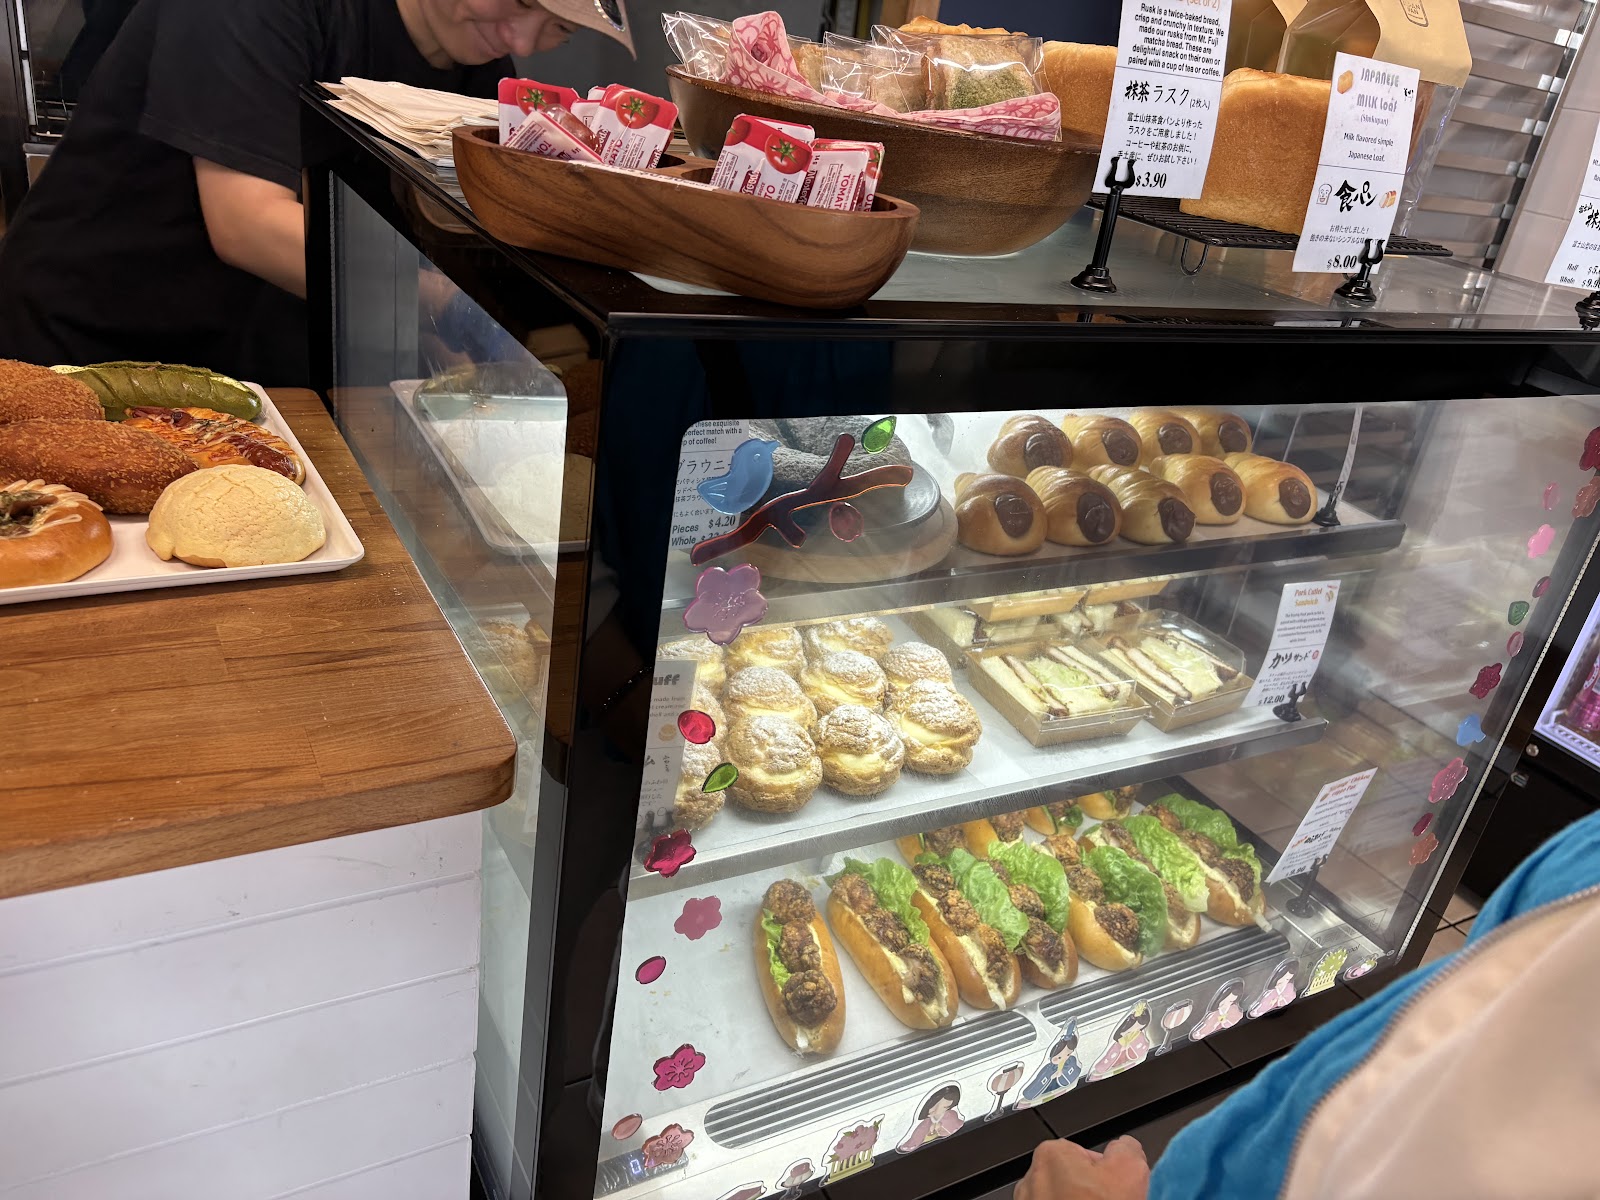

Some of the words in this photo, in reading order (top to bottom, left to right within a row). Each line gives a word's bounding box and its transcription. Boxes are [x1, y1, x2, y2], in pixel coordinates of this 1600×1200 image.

[1140, 2, 1156, 14] Rusk
[1156, 6, 1162, 15] is
[1168, 8, 1202, 22] twice-baked
[1203, 15, 1220, 26] bread,
[1134, 14, 1150, 24] crisp
[1150, 16, 1162, 25] and
[1163, 19, 1186, 31] crunchy
[1187, 22, 1192, 31] in
[1193, 24, 1214, 35] texture.
[1215, 28, 1224, 36] We
[1139, 25, 1155, 34] made
[1156, 28, 1166, 36] our
[1167, 30, 1183, 40] rusks
[1184, 32, 1198, 41] from
[1198, 34, 1206, 44] Mt.
[1208, 36, 1219, 46] Fuji
[1132, 44, 1161, 56] delightful
[1162, 50, 1179, 59] snack
[1188, 53, 1201, 62] their
[1202, 56, 1213, 64] own
[1144, 37, 1165, 46] matcha
[1166, 40, 1184, 50] bread.
[1185, 42, 1202, 53] These
[1203, 46, 1212, 54] are
[1128, 55, 1147, 65] paired
[1148, 59, 1160, 68] with
[1166, 62, 1177, 72] cup
[1178, 63, 1184, 71] of
[1185, 64, 1193, 73] tea
[1202, 67, 1220, 77] coffee.
[1125, 80, 1150, 102] 抹茶
[1154, 86, 1190, 106] ラスク
[1127, 112, 1203, 129] 富士山抹茶食パンより作った
[1344, 132, 1354, 141] Milk
[1356, 134, 1377, 144] flavored
[1378, 138, 1393, 147] simple
[1348, 150, 1372, 160] Japanese
[1136, 172, 1167, 188] $3.90
[834, 174, 851, 210] TOMAT
[1334, 179, 1378, 213] 食パン
[1327, 255, 1358, 270] $8.00
[1588, 266, 1600, 275] $5.
[707, 428, 725, 436] match
[713, 420, 740, 428] exquisite
[672, 524, 699, 534] Pieces
[708, 515, 736, 529] $4.20
[671, 536, 696, 546] Whole
